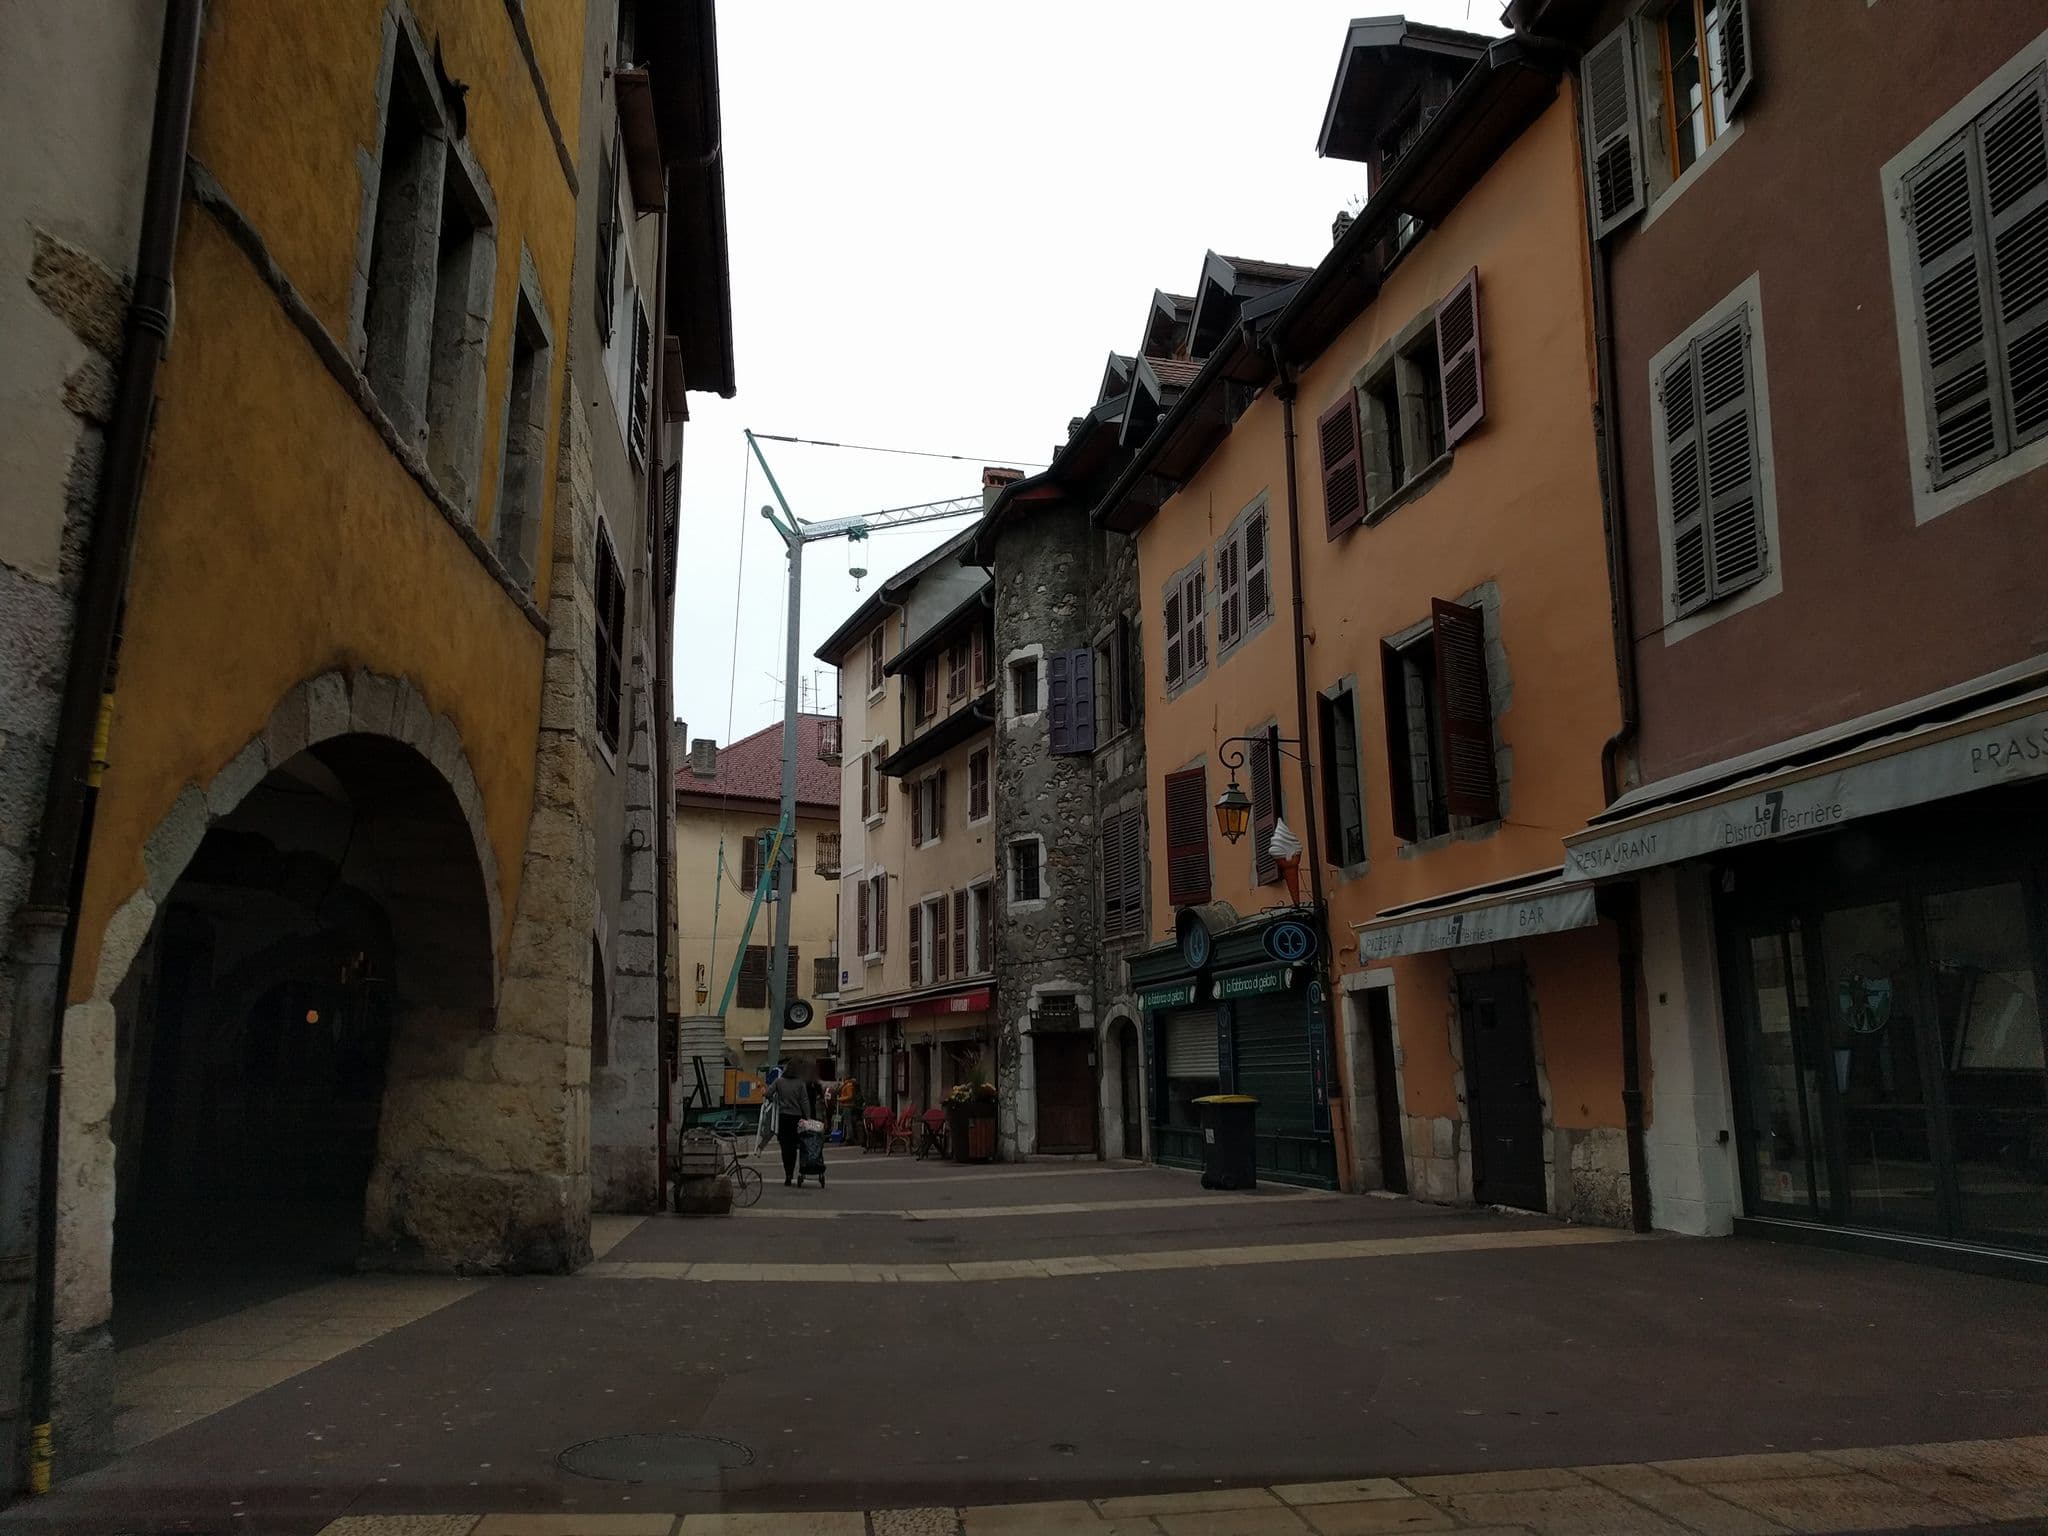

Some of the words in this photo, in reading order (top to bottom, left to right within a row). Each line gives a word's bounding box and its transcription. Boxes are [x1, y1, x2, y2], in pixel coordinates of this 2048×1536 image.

[1724, 822, 1769, 845] Bistrot
[1781, 801, 1842, 832] Perrière
[1755, 805, 1771, 823] Le
[1765, 790, 1784, 834] 7
[1574, 834, 1658, 871] RESTAURANT
[1519, 906, 1545, 927] BAR
[1366, 934, 1404, 952] PIZZERIA
